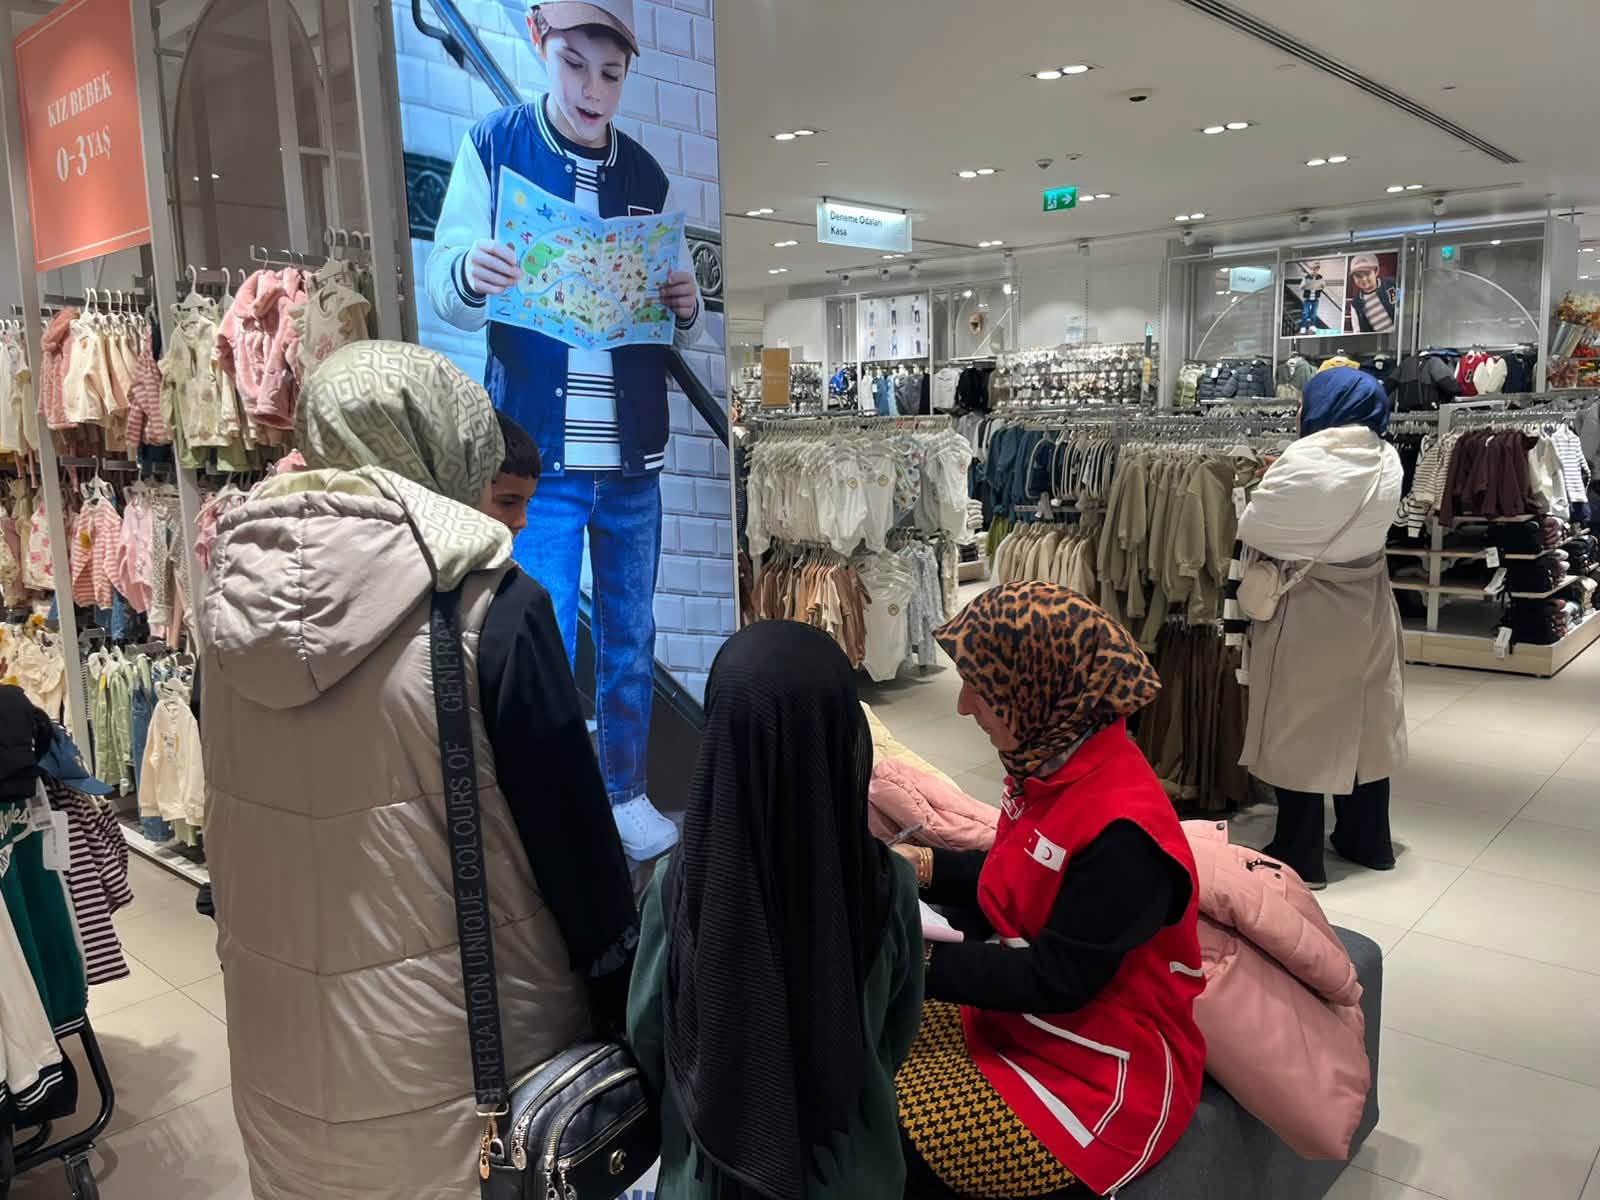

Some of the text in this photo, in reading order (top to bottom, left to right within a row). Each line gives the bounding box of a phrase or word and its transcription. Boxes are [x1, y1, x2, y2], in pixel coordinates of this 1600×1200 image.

[48, 69, 112, 128] KIZ BEBEK
[56, 124, 111, 183] 0-3 YAŞ
[830, 209, 858, 224] Deneme
[830, 226, 848, 236] Kasa
[433, 610, 463, 712] GENERAT
[446, 741, 471, 769] OF
[449, 776, 481, 880] COLOURS
[457, 887, 489, 967] UNIQUE
